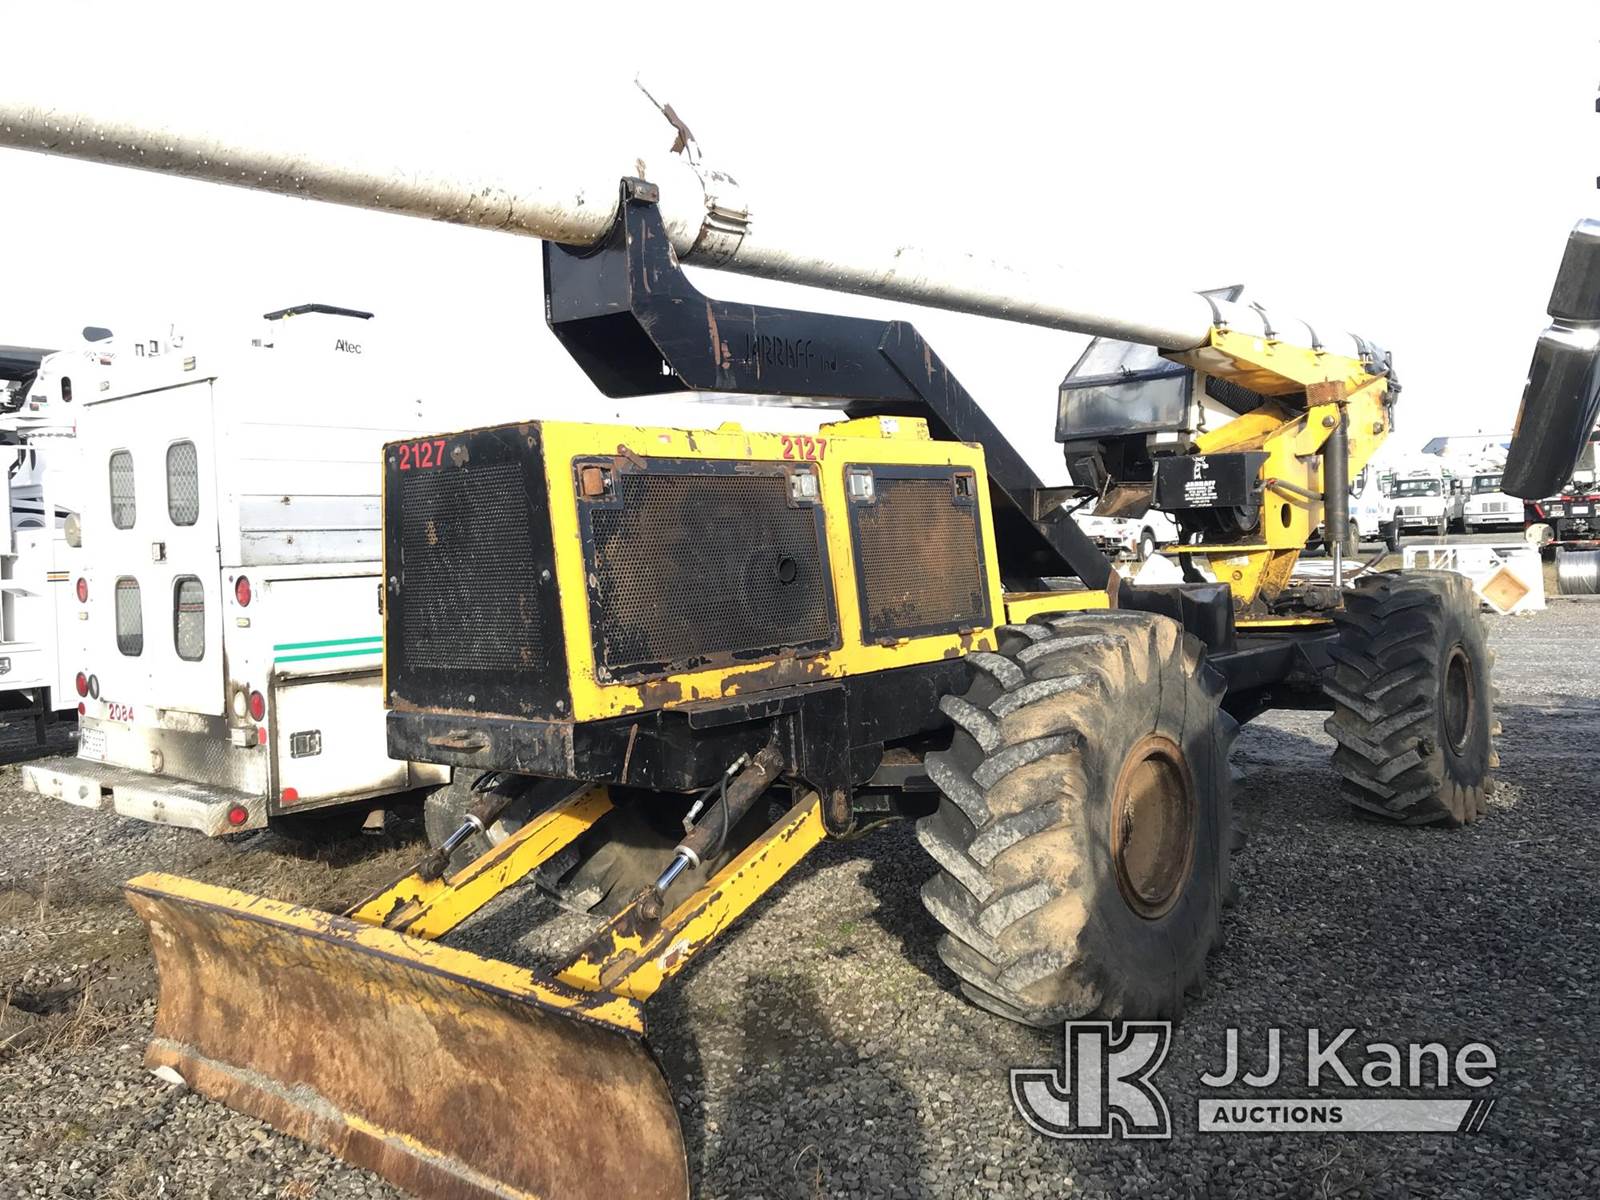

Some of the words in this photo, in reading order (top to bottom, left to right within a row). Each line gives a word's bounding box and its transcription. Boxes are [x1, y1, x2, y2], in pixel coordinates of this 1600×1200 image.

[335, 339, 362, 354] Altec
[399, 440, 447, 471] 2127
[781, 435, 827, 461] 2127
[108, 703, 134, 722] 2084
